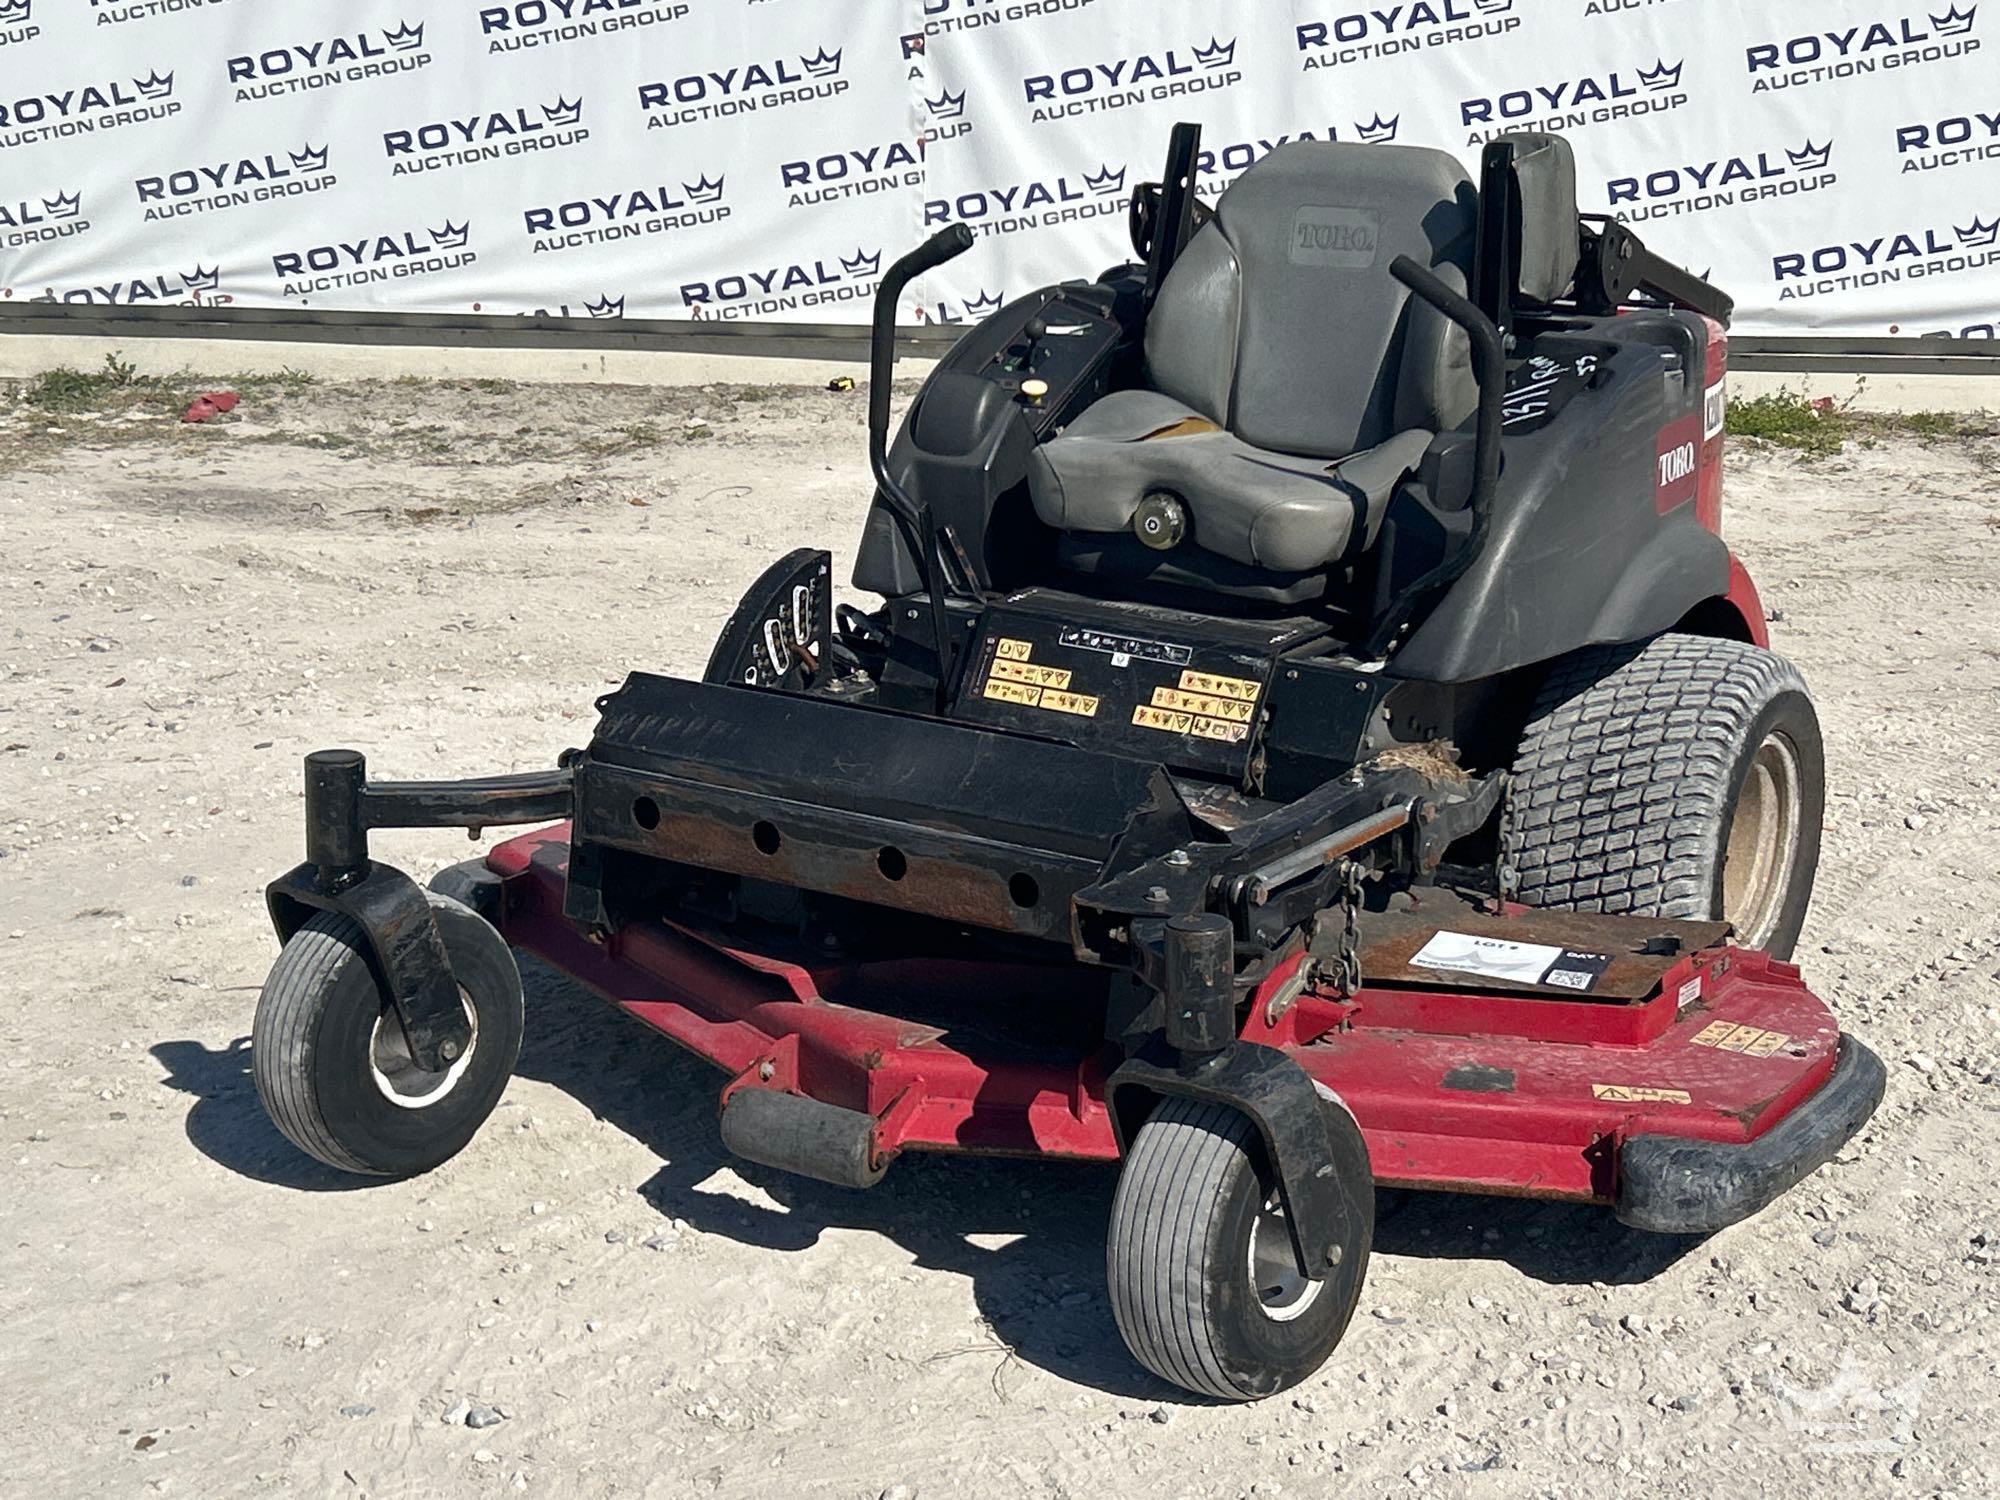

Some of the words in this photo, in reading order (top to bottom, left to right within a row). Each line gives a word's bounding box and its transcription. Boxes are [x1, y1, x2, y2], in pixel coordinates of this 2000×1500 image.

[488, 21, 597, 54] AUCTION
[602, 4, 690, 33] GROUP
[924, 10, 1001, 36] CTION
[1296, 0, 1470, 51] ROYAL
[1302, 37, 1421, 72] AUCTION
[1427, 17, 1522, 47] GROUP
[1746, 18, 1928, 73] ROYAL
[227, 34, 385, 83] ROYAL
[234, 70, 341, 103] AUCTION
[346, 53, 432, 81] GROUP
[1024, 51, 1193, 103] ROYAL
[1752, 58, 1876, 94] AUCTION
[1882, 39, 1981, 69] GROUP
[638, 60, 802, 110] ROYAL
[647, 98, 756, 130] AUCTION
[762, 80, 849, 109] GROUP
[1031, 89, 1145, 123] AUCTION
[1151, 71, 1242, 100] GROUP
[1460, 73, 1637, 126] ROYAL
[1592, 93, 1688, 124] GROUP
[0, 118, 95, 148] UCTION
[99, 102, 182, 129] GROUP
[383, 108, 544, 157] ROYAL
[1896, 112, 2000, 153] ROY
[392, 145, 500, 177] AUCTION
[504, 128, 590, 157] GROUP
[1901, 143, 2000, 174] AUCTIO
[136, 155, 291, 203] ROYAL
[143, 191, 249, 222] AUCTION
[254, 175, 337, 202] GROUP
[788, 171, 898, 208] AUCTION
[924, 177, 1084, 226] ROYAL
[1607, 153, 1785, 205] ROYAL
[1614, 192, 1733, 224] AUCTION
[1739, 173, 1837, 203] GROUP
[8, 221, 91, 247] GROUP
[524, 186, 684, 234] ROYAL
[533, 222, 641, 254] AUCTION
[646, 206, 731, 233] GROUP
[272, 232, 431, 278] ROYAL
[283, 267, 388, 297] AUCTION
[392, 252, 477, 279] GROUP
[1773, 229, 1953, 281] ROYAL
[680, 261, 841, 307] ROYAL
[1778, 268, 1901, 301] AUCTION
[1474, 940, 1506, 950] LOT
